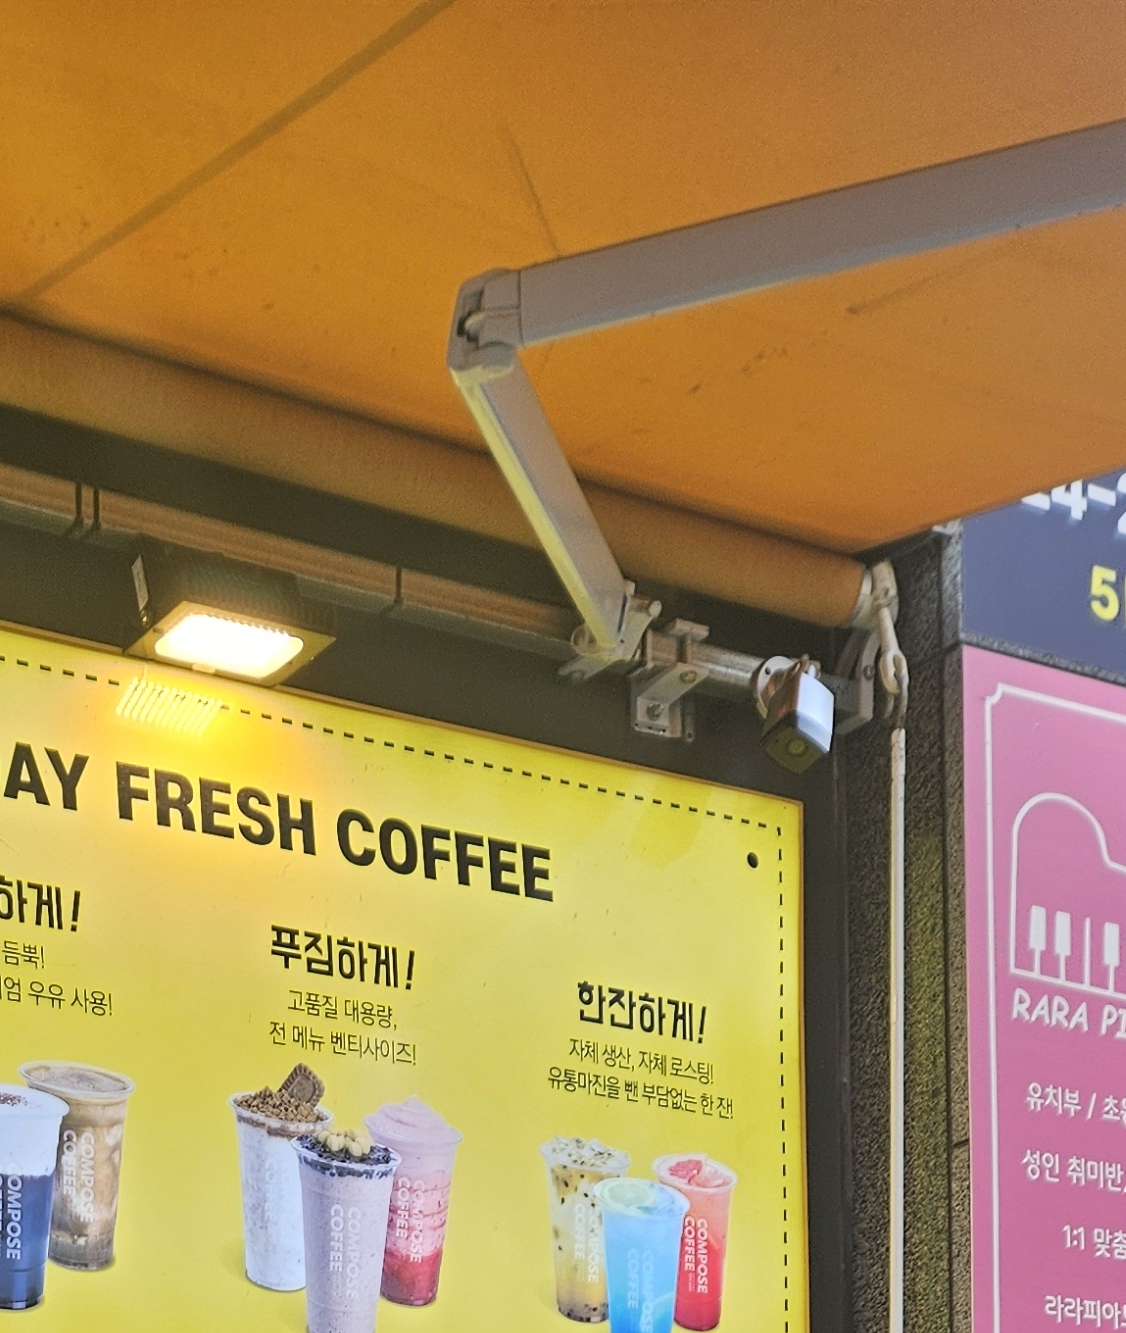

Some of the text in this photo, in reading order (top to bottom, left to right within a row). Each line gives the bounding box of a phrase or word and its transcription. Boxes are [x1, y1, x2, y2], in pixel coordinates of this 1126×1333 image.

[116, 761, 317, 856] FRESH
[337, 808, 554, 902] COFFEE
[1, 940, 46, 970] 듬뿍!
[270, 924, 416, 991] 푸짐하게!
[27, 980, 66, 1009] 우유
[70, 987, 114, 1017] 사용!
[287, 989, 398, 1032] 고품질 대용량,
[577, 980, 707, 1044] 한잔하게!
[1011, 988, 1089, 1032] RARA
[268, 1020, 418, 1066] 전 메뉴 벤티사이즈!
[568, 1037, 714, 1085] 자체 생산, 자체 로스팅!
[547, 1066, 734, 1120] 유통마진을 뺀 부담없는 한 잔!
[1026, 1081, 1082, 1118] 유치부
[62, 1129, 77, 1196] COFFEE
[79, 1131, 95, 1224] COMPOSE
[1022, 1149, 1060, 1183] 성인
[395, 1176, 411, 1237] COFFEE
[329, 1203, 344, 1272] COFFEE
[684, 1216, 695, 1271] COFFEE
[697, 1217, 709, 1294] COMPOSE
[1062, 1225, 1086, 1251] 1:1
[1044, 1295, 1126, 1330] 라라피아
